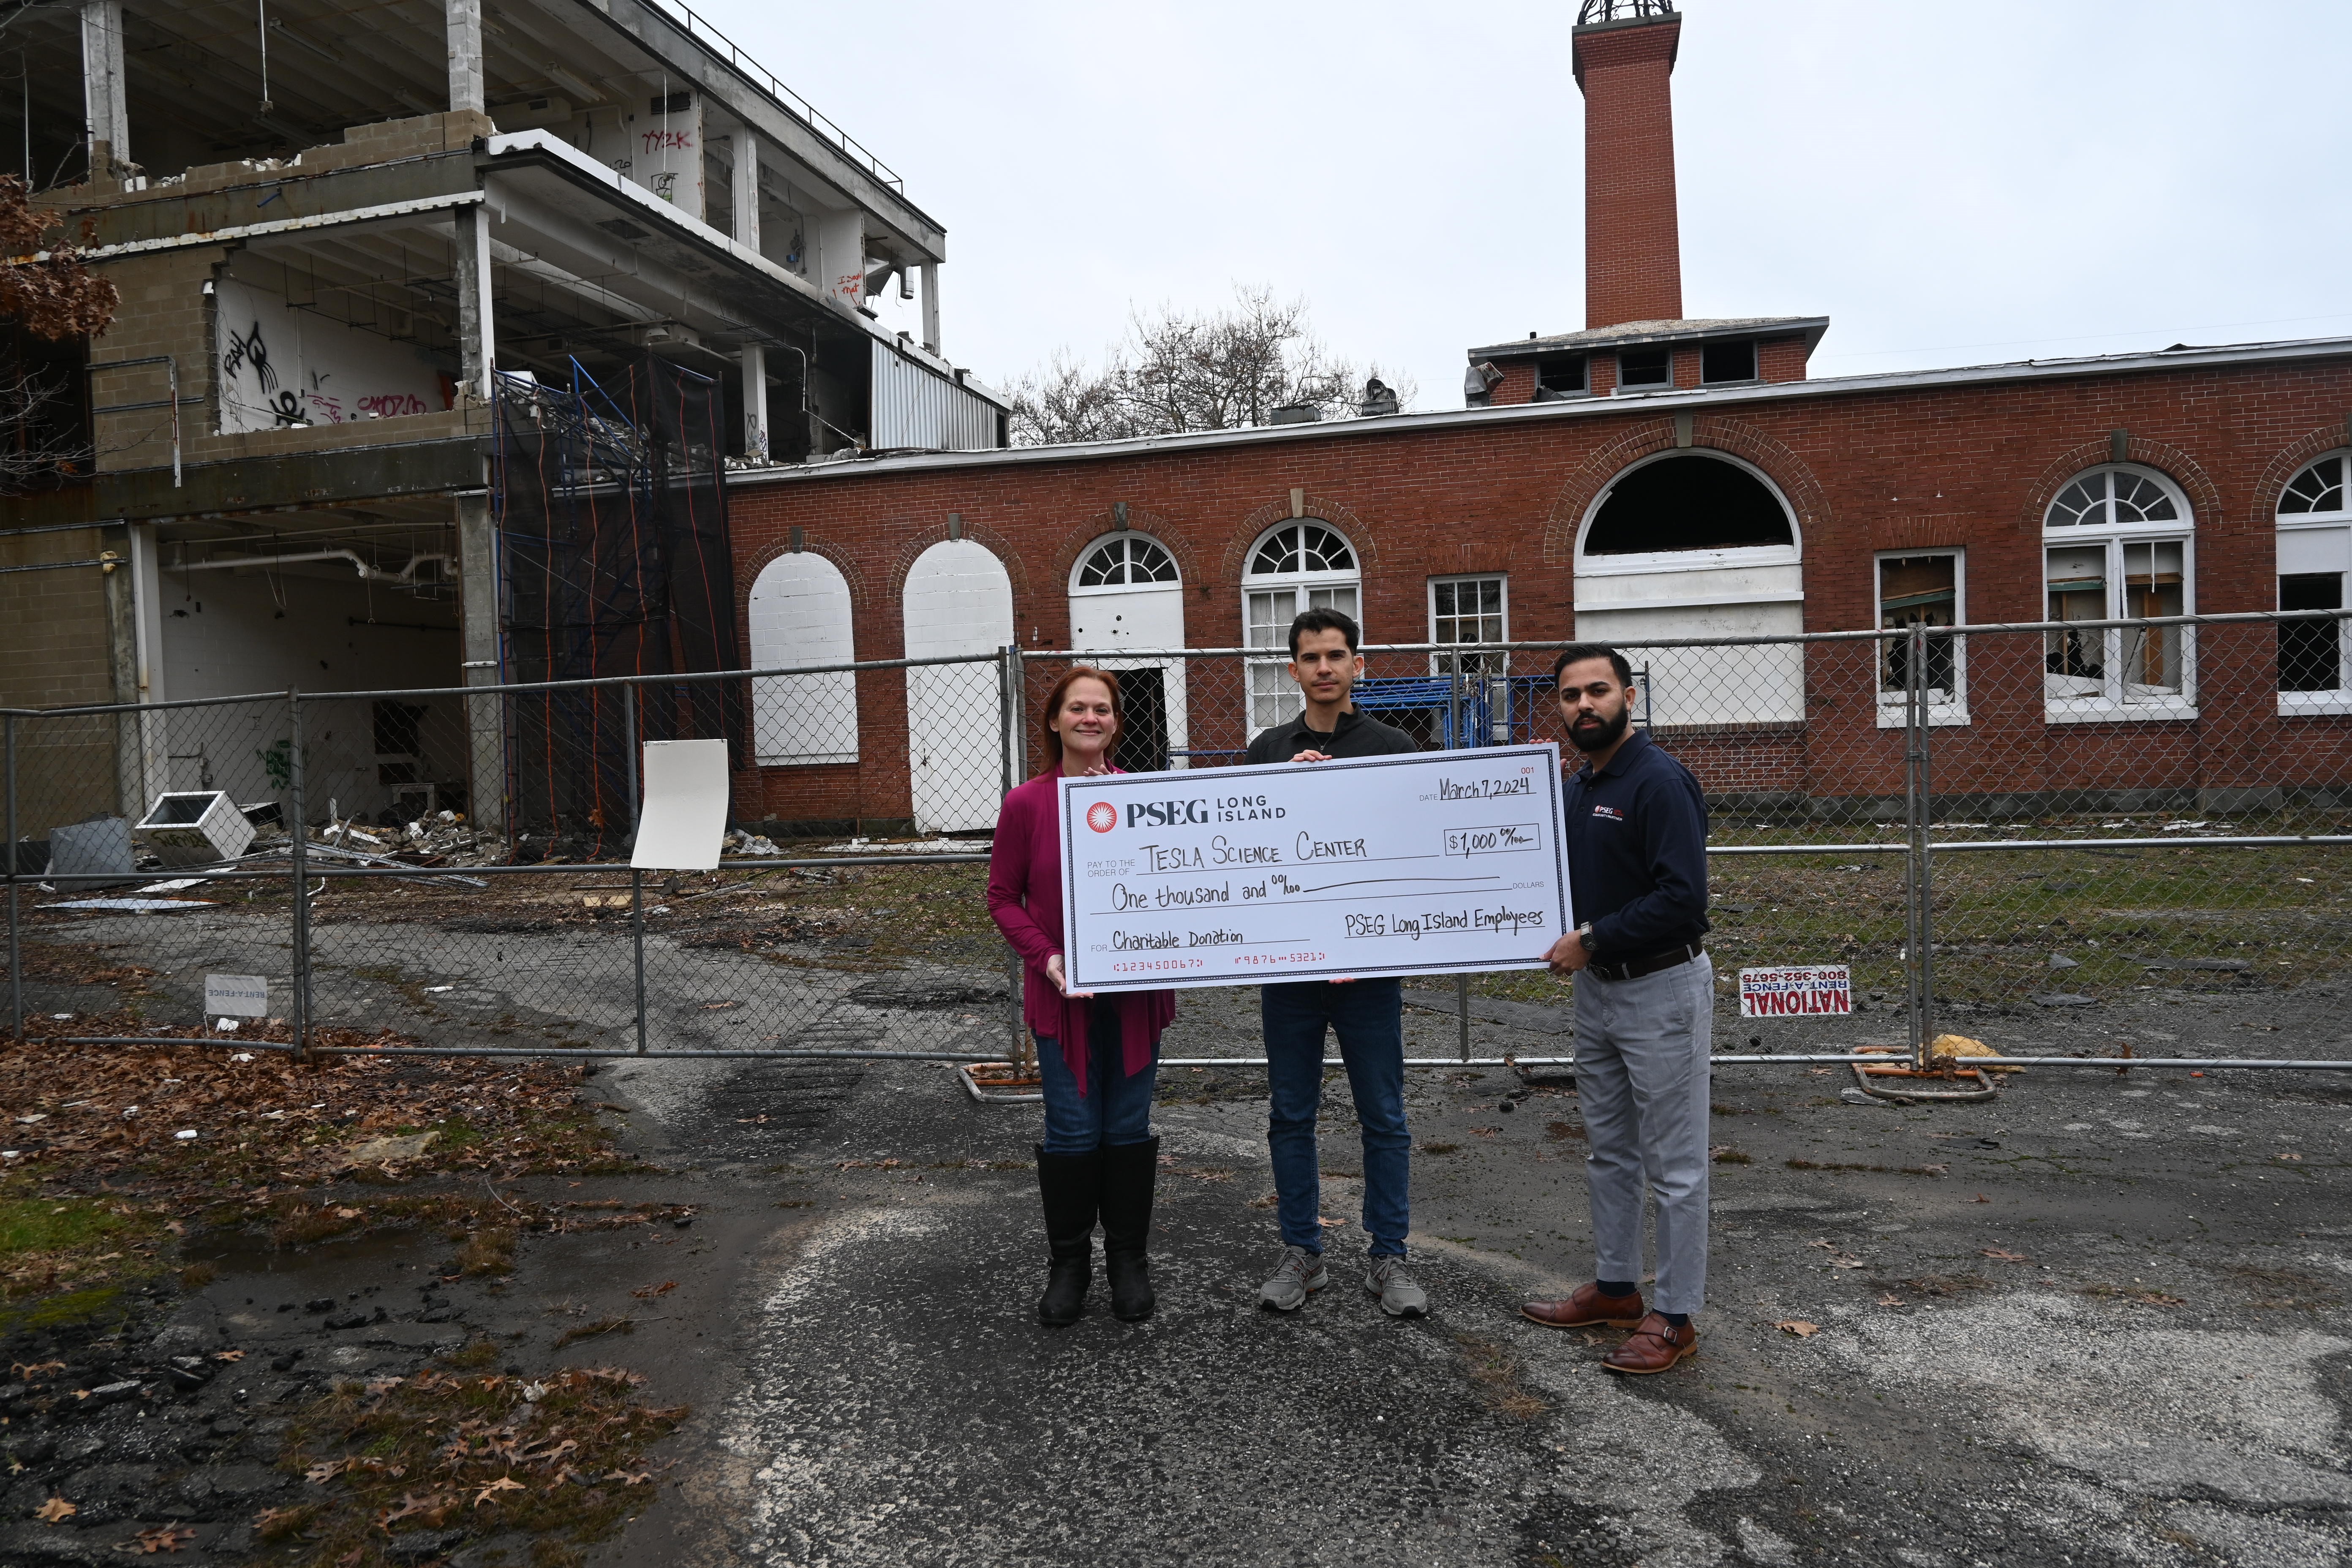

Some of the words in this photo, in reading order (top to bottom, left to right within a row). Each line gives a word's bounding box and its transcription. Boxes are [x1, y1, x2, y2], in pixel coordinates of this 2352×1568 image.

[1440, 778, 1478, 800] March
[1218, 795, 1266, 808] LONG
[1127, 799, 1209, 828] PSEG
[1218, 808, 1285, 822] ISLAND
[1139, 845, 1204, 872] TESLA
[1211, 835, 1282, 864] SCIENCE
[1296, 831, 1367, 860] CENTER
[1450, 833, 1497, 859] $1,000
[1088, 869, 1116, 877] ORDER
[1113, 883, 1148, 910] One
[1155, 881, 1229, 906] thousand
[1243, 881, 1266, 899] and
[1345, 914, 1385, 936] PSEG
[1392, 914, 1420, 940] Long
[1421, 910, 1467, 930] Island
[1475, 906, 1544, 936] Employees
[1113, 930, 1180, 950] Charitable
[1190, 929, 1243, 947] Donation
[1743, 971, 1846, 983] 800-352-5675
[1743, 981, 1847, 991] RENT-A-FENCE
[208, 990, 264, 998] RENT-A-FENCE
[1744, 990, 1848, 1015] NATIONAL
